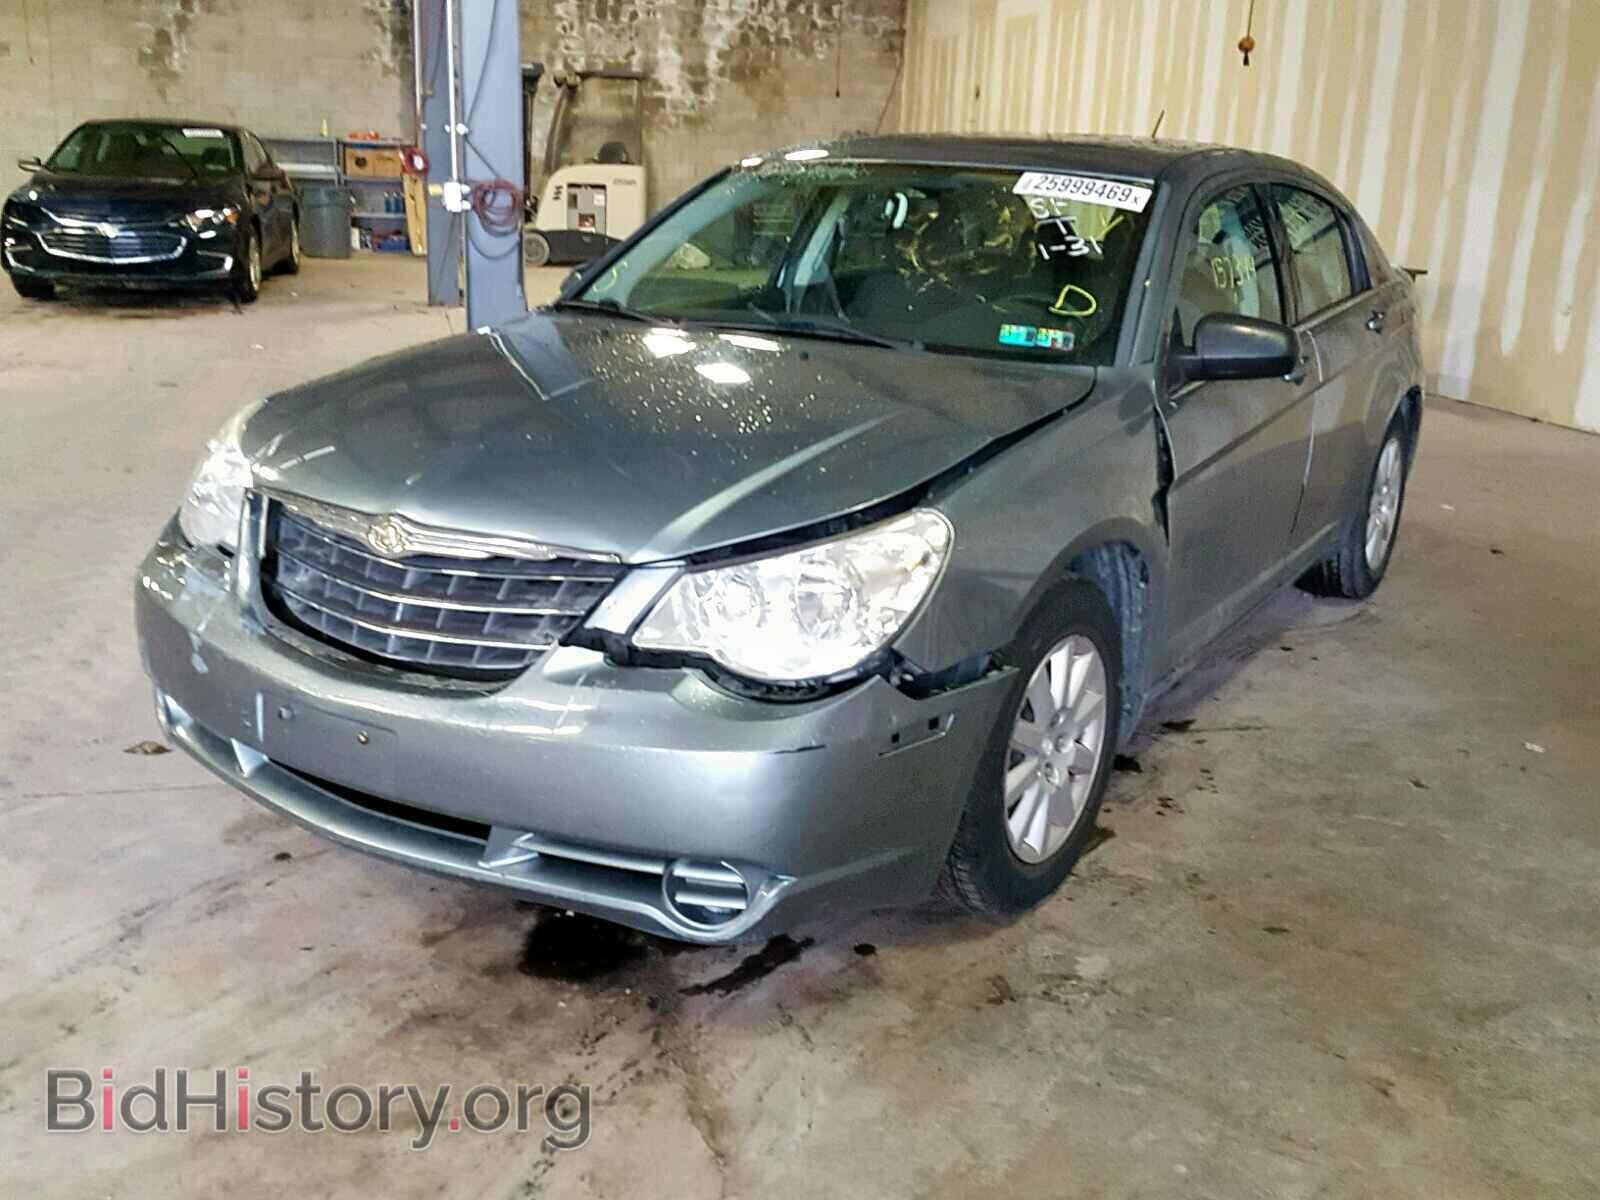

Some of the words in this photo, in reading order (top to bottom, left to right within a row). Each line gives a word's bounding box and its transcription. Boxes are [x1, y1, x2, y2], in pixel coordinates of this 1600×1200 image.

[1033, 174, 1133, 203] 25999469
[1038, 235, 1103, 260] 1-31
[1048, 283, 1097, 317] D
